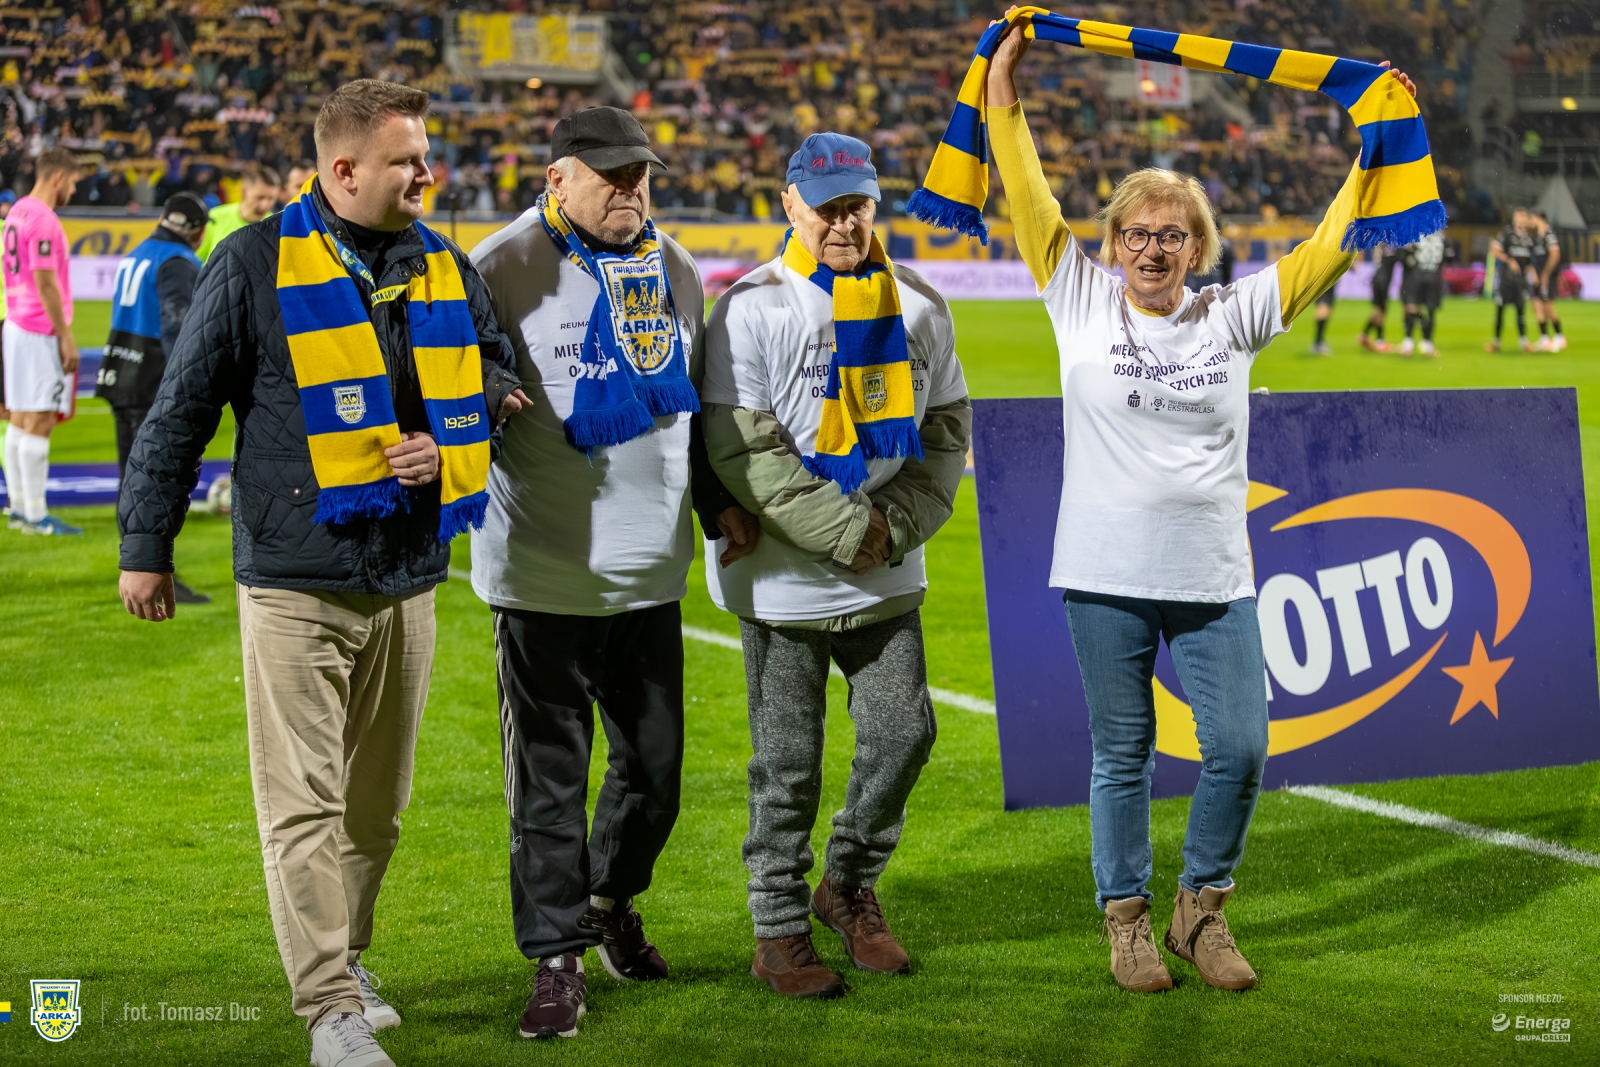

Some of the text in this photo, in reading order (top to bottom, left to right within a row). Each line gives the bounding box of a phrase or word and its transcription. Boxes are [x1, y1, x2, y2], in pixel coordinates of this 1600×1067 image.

[561, 320, 588, 330] REUMA
[622, 319, 666, 334] ARKA
[1113, 362, 1143, 379] OSÓB
[1206, 370, 1228, 385] 2025
[1167, 404, 1216, 414] EKSTRAKLASA
[444, 412, 480, 429] 1929
[1256, 536, 1454, 701] OTTO
